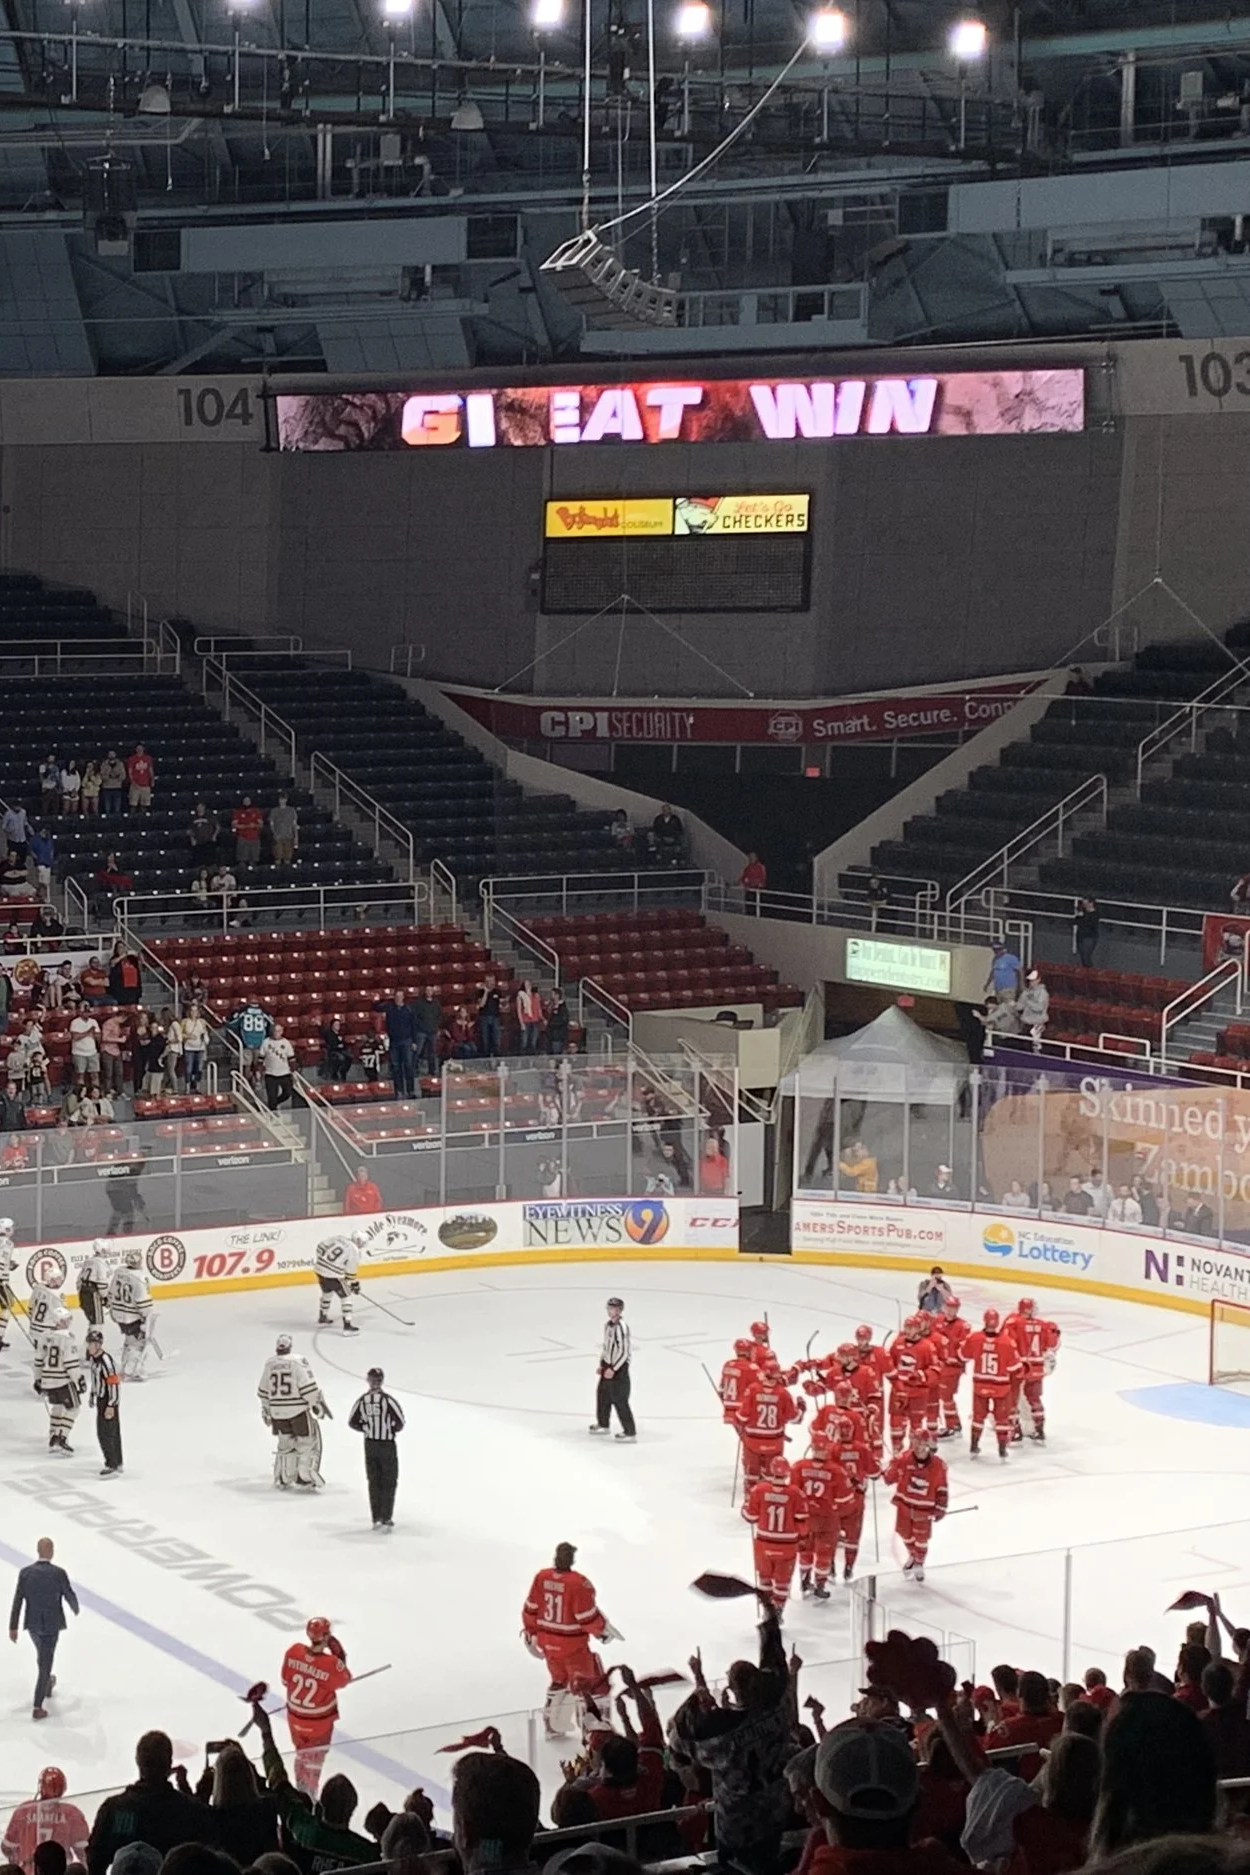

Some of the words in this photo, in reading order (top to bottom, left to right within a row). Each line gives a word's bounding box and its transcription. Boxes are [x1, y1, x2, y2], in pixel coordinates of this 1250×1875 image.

[177, 387, 254, 427] 104
[750, 379, 938, 439] WIN
[721, 513, 806, 530] CHECKERS
[540, 711, 610, 738] CPI
[611, 711, 694, 740] SECURITY
[812, 715, 877, 738] Smart.
[883, 709, 958, 729] Secure.
[218, 1155, 251, 1167] verizon
[524, 1202, 624, 1220] EYEWITNESS
[230, 1233, 251, 1245] THE
[528, 1216, 623, 1246] NEWS
[1017, 1230, 1031, 1241] NC
[1033, 1232, 1075, 1246] Education
[160, 1248, 173, 1269] B
[192, 1247, 275, 1280] 107.9
[1017, 1240, 1094, 1271] Lottery
[1030, 1334, 1041, 1356] 4
[980, 1352, 999, 1376] 15
[269, 1372, 292, 1397] 35
[756, 1403, 778, 1429] 28
[765, 1505, 786, 1533] 11
[1, 1470, 306, 1633] POWERADE
[543, 1592, 563, 1624] 31
[290, 1673, 318, 1708] 22
